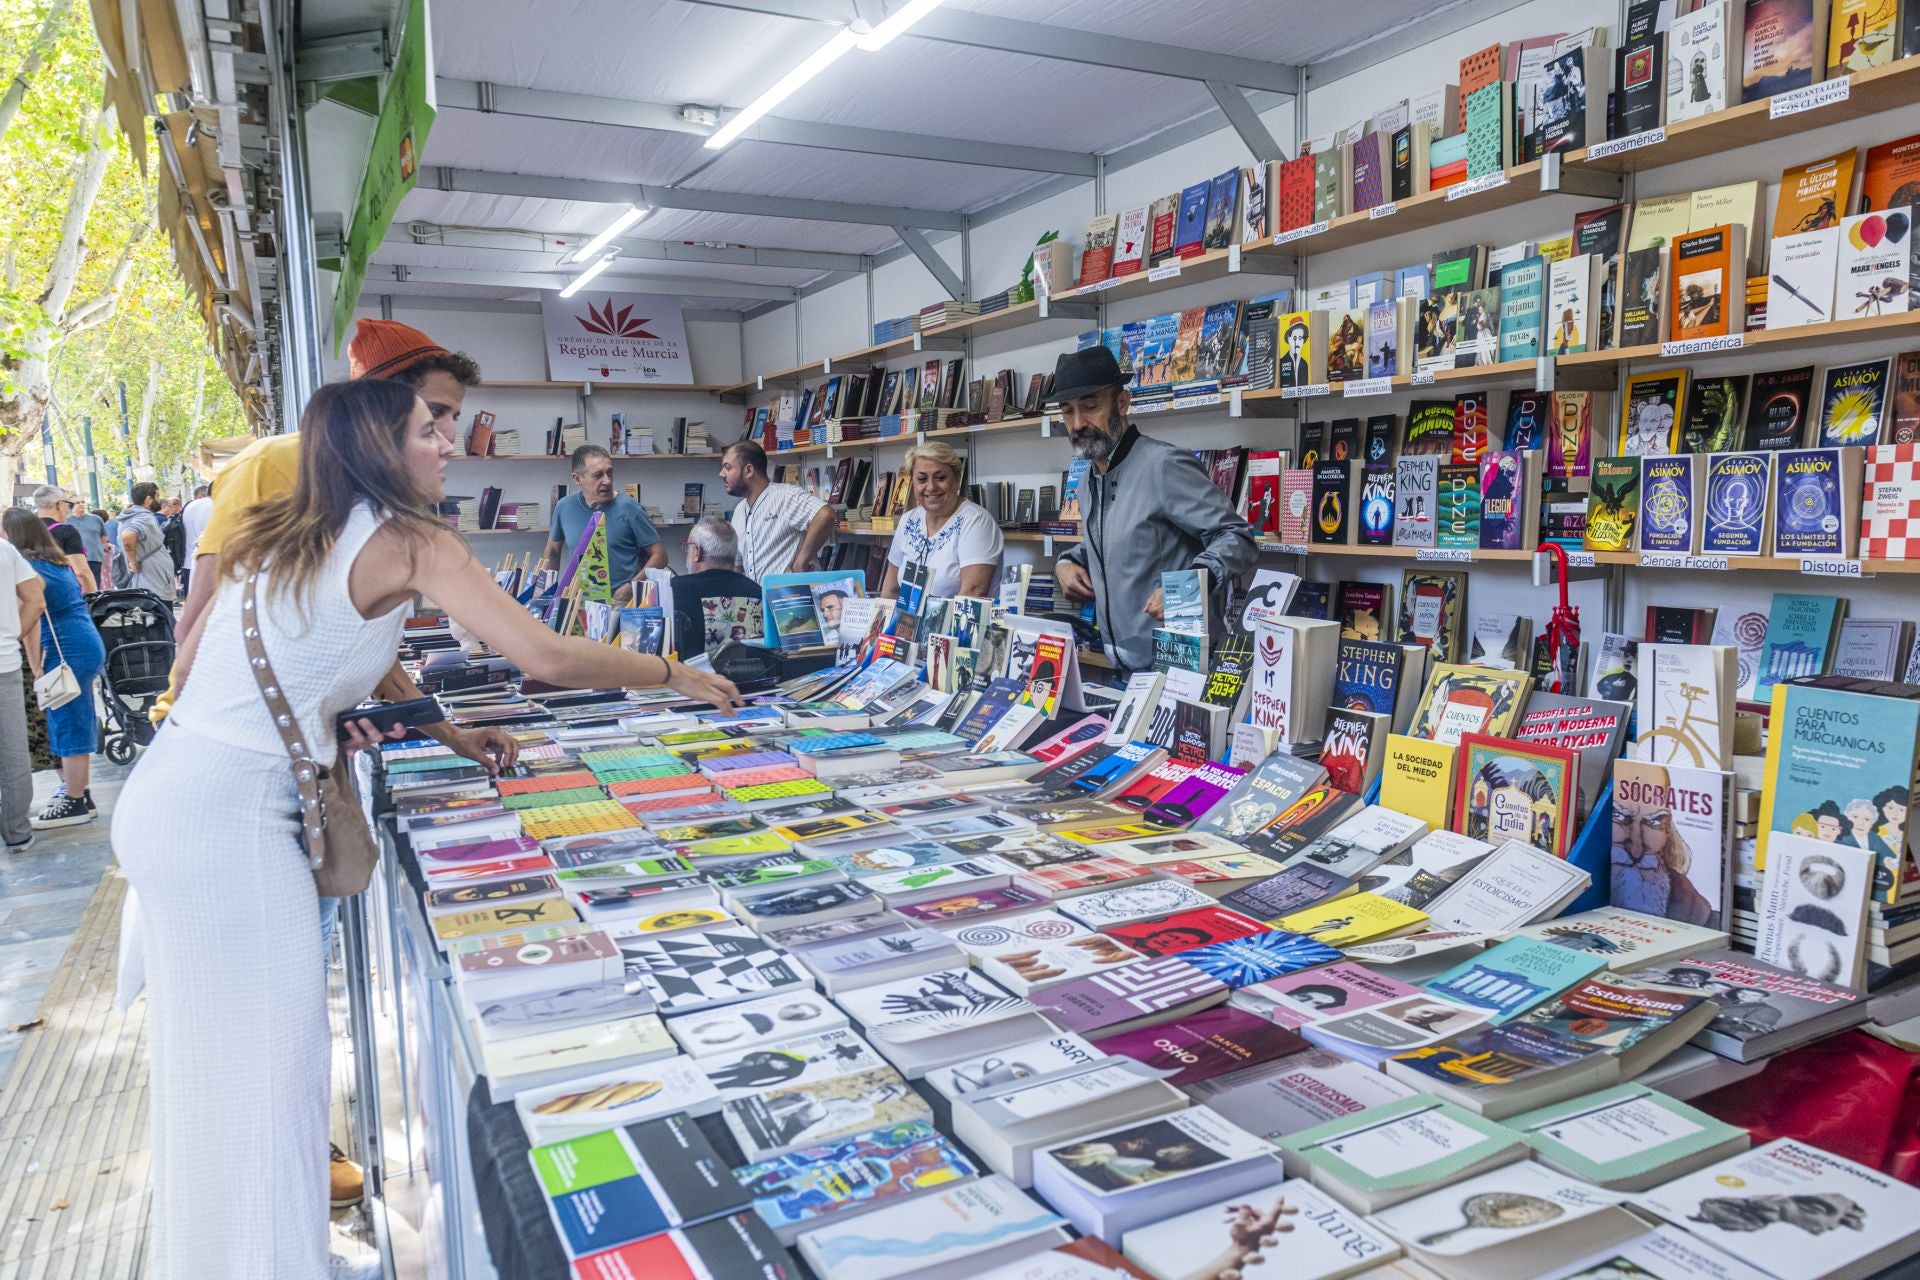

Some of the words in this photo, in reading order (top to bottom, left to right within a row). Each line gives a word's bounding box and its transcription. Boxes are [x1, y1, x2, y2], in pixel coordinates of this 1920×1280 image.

[1630, 24, 1648, 34] CAMUS
[1631, 17, 1649, 30] ALBERT
[1692, 21, 1707, 32] JULIO
[1754, 18, 1779, 31] GABRIEL
[1754, 25, 1777, 37] GARCÍA
[1691, 35, 1710, 47] Rayuela
[1754, 29, 1785, 44] MÁRQUEZ
[1773, 94, 1788, 105] NOS
[1788, 86, 1825, 102] ENCANTA
[1826, 79, 1848, 93] LEER
[1544, 119, 1570, 135] LEONARDO
[1544, 128, 1564, 140] PADURA
[1588, 130, 1664, 159] Latinoamérica
[1799, 177, 1808, 187] EL
[1809, 168, 1838, 184] ÚLTIMO
[1796, 179, 1837, 198] MOHICANO
[1371, 204, 1395, 218] Teatro
[1696, 199, 1715, 210] Henry
[1714, 197, 1733, 207] Miller
[1639, 207, 1657, 218] Henry
[1658, 206, 1675, 215] Miller
[1273, 229, 1303, 243] Colección
[1304, 222, 1328, 236] Austral
[1582, 225, 1607, 235] CHANDLER
[1583, 220, 1607, 230] RAYMOND
[1681, 238, 1698, 249] Charles
[1698, 233, 1721, 245] Bukowski
[1850, 262, 1870, 274] MARX
[1876, 260, 1901, 270] ENGELS
[1508, 275, 1516, 286] El
[1517, 269, 1536, 283] niño
[1507, 299, 1534, 316] pijama
[1624, 309, 1646, 319] WILLIAM
[1624, 314, 1649, 324] FAULKNER
[1155, 327, 1179, 337] MANGA
[1509, 331, 1530, 345] rayas
[557, 335, 593, 344] GREMIO
[610, 338, 652, 346] EDITORES
[1663, 337, 1742, 356] Norteamérica
[559, 343, 607, 359] Región
[612, 345, 628, 358] de
[632, 346, 679, 359] Murcia
[1411, 374, 1434, 384] Rusia
[1833, 371, 1881, 389] ASIMOV
[1843, 367, 1874, 377] ISAAC
[1412, 412, 1423, 423] LA
[1424, 406, 1455, 417] GUERRA
[1769, 406, 1791, 417] HIJOS
[1409, 418, 1454, 442] MUNDOS
[1462, 399, 1478, 462] DUNE
[1562, 402, 1578, 463] DUNE
[1759, 436, 1792, 448] HOMBRES
[1398, 460, 1434, 475] STEPHEN
[1597, 461, 1613, 469] Ray
[1598, 466, 1633, 476] BRADBURY
[1649, 466, 1685, 478] ASIMOV
[1717, 463, 1763, 476] ASIMOV
[1785, 461, 1832, 474] ASIMOV
[1367, 472, 1394, 482] STEPHEN
[1400, 475, 1432, 491] KING
[1362, 482, 1396, 500] KING
[1878, 486, 1902, 494] STEFAN
[1451, 478, 1467, 533] DUNE
[1487, 496, 1512, 514] LEGIÓN
[1876, 508, 1896, 516] ajedrez
[1648, 532, 1683, 540] FUNDACIÓN
[1713, 538, 1752, 546] FUNDACIÓN
[1791, 539, 1837, 547] FUNDACIÓN
[1798, 532, 1827, 540] LÍMITES
[1259, 543, 1282, 552] Extremo
[1284, 544, 1307, 554] Oriente
[1416, 549, 1449, 561] Stephen
[1450, 549, 1470, 561] King
[1566, 552, 1594, 567] Sagas
[1641, 554, 1681, 567] Ciencia
[1684, 556, 1728, 569] Ficción
[1802, 560, 1859, 576] Distopía
[1417, 600, 1440, 609] CUENTOS
[1787, 605, 1820, 614] FELICIDAD
[1791, 599, 1809, 607] SOBRE
[1785, 618, 1817, 627] BREVEDAD
[1788, 613, 1806, 621] SOBRE
[1792, 624, 1800, 632] LA
[1801, 625, 1816, 633] VIDA
[1156, 641, 1193, 656] QUINTA
[1342, 645, 1396, 664] STEPHEN
[1156, 651, 1193, 666] ESTACIÓN
[1657, 659, 1681, 667] DELIBES
[1211, 672, 1240, 684] METRO
[1215, 665, 1243, 676] GLUKHOVSKY
[1338, 660, 1394, 690] KING
[1666, 667, 1690, 675] CAMINO
[1834, 667, 1884, 679] ESTOICISMO?
[1208, 682, 1236, 698] 2034
[1253, 691, 1286, 715] STEPHEN
[1445, 710, 1481, 724] CUENTOS
[1525, 707, 1567, 722] FILOSOFÍA
[1568, 706, 1581, 716] DE
[1581, 705, 1593, 716] LA
[1796, 705, 1859, 726] CUENTOS
[1254, 709, 1286, 737] KING
[1333, 717, 1369, 733] STEPHEN
[1517, 720, 1556, 738] NCIÓN
[1557, 714, 1617, 734] MODERNA
[1795, 717, 1827, 732] PARA
[1323, 729, 1369, 764] KING
[1794, 728, 1886, 754] MURCIANICAS
[1178, 742, 1206, 759] METRO
[1393, 751, 1404, 761] LA
[1405, 752, 1443, 769] SOCIEDAD
[1396, 762, 1411, 772] DEL
[1413, 765, 1438, 779] MIEDO
[1251, 776, 1292, 800] ESPACIO
[1495, 793, 1529, 814] Cuentos
[1618, 777, 1713, 816] SÓCRATES
[1494, 811, 1525, 831] India
[1785, 855, 1793, 877] Freud
[1471, 878, 1533, 911] ESTOICISMO?
[1766, 891, 1779, 918] Mann
[1575, 921, 1654, 944] estoicos
[1609, 914, 1676, 935] Felices
[1761, 918, 1775, 962] Thomas
[1324, 968, 1337, 976] DE
[1338, 973, 1354, 982] LAS
[1356, 979, 1399, 999] MUJERES
[1714, 972, 1761, 987] BOB
[1761, 984, 1841, 1004] DYLAN
[1061, 992, 1101, 1016] LIBERTAD
[1581, 984, 1685, 1011] Estoicismo
[1049, 1038, 1095, 1064] SART
[1153, 1038, 1199, 1064] OSHO
[1211, 1033, 1253, 1059] TANTRA
[1279, 1078, 1299, 1090] PARA
[1297, 1084, 1350, 1117] PRINCIPIANTES
[1287, 1072, 1367, 1113] ESTOICISMO
[1785, 1143, 1889, 1188] Meditaciones
[1304, 1207, 1382, 1259] Jung
